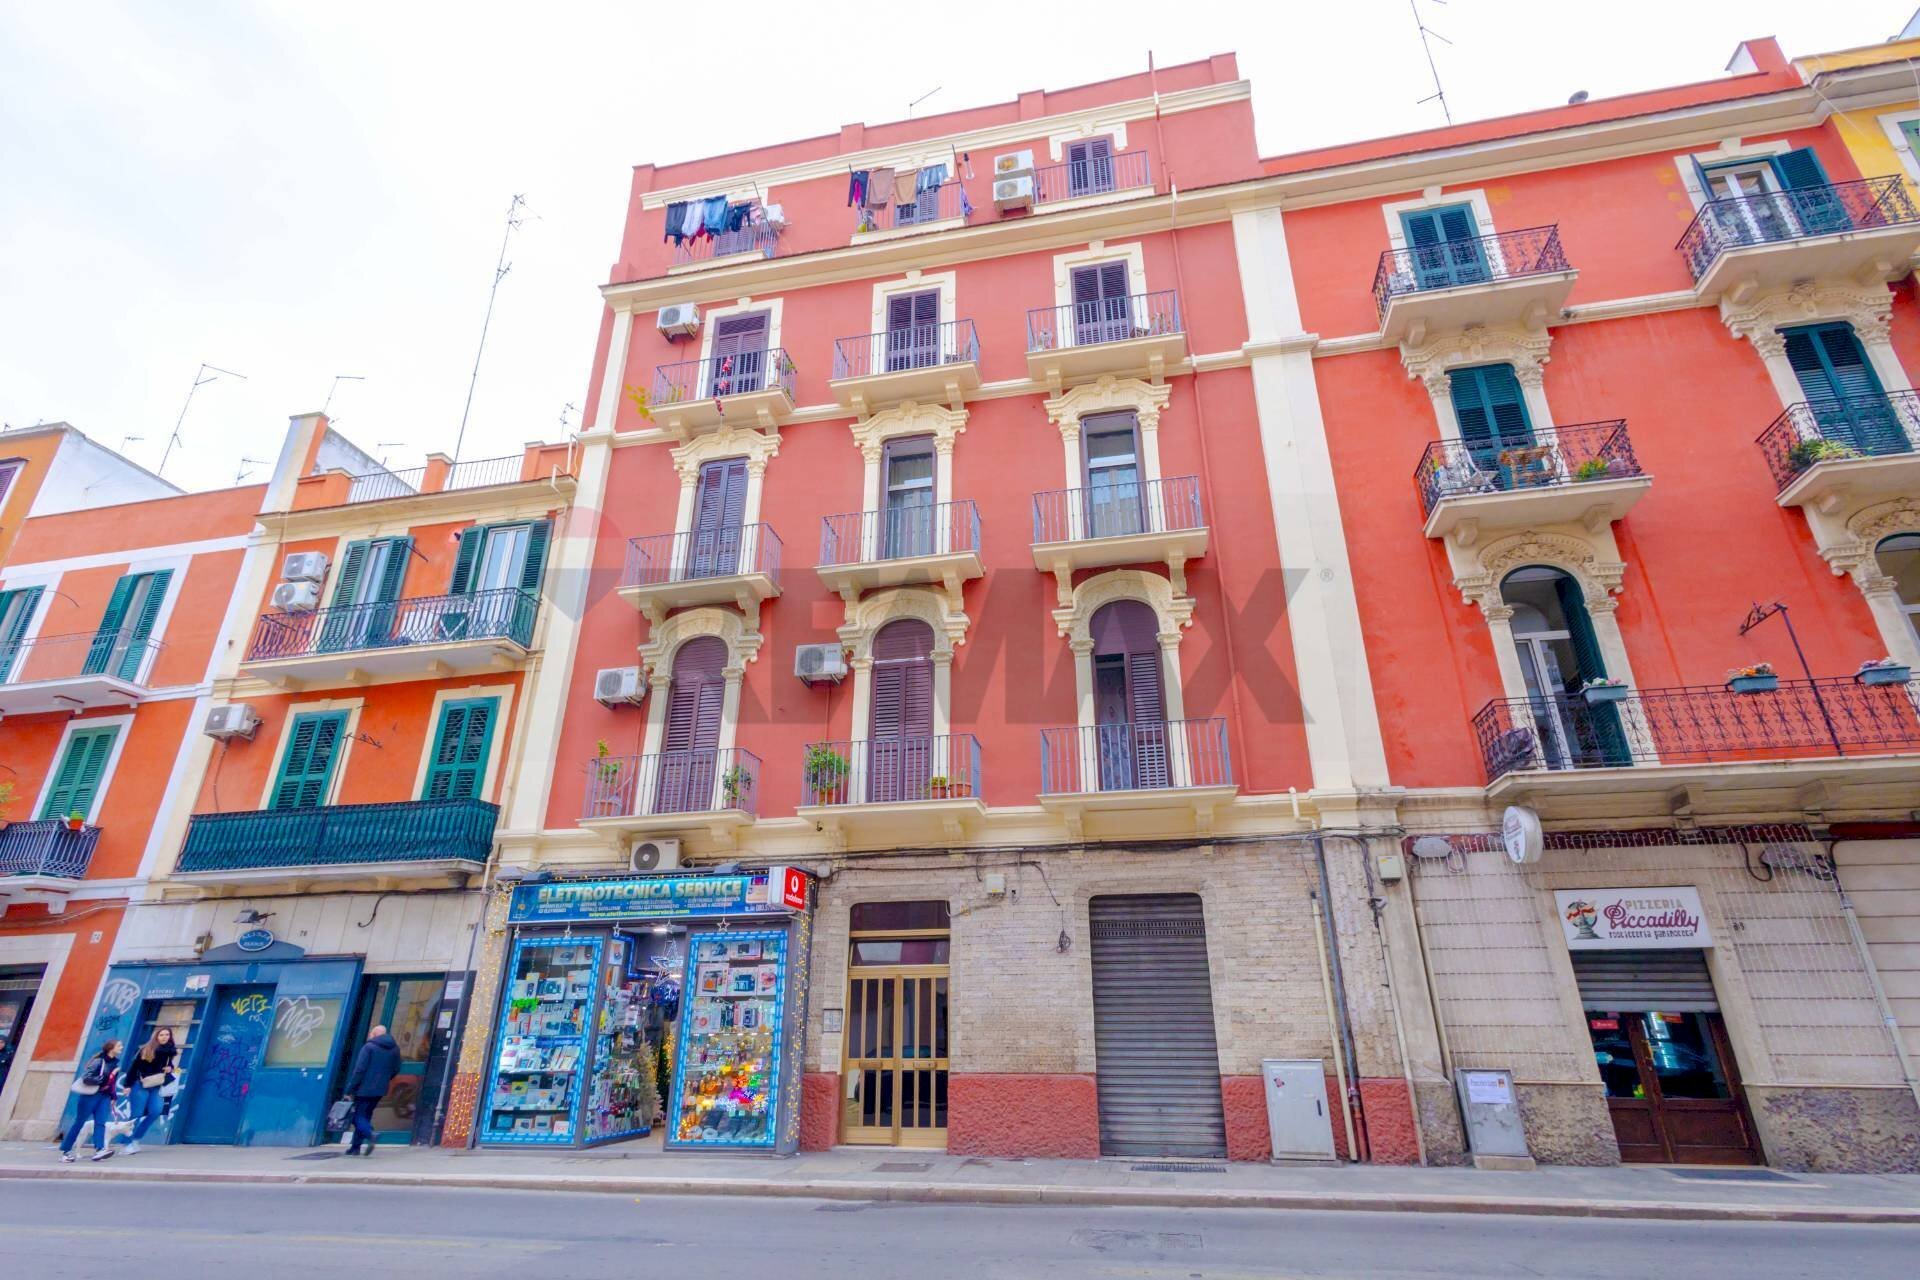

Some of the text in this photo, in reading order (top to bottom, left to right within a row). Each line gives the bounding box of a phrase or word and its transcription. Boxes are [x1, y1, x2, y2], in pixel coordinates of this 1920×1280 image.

[538, 883, 671, 900] ELETTROTECNICA
[675, 880, 742, 898] SERVICE
[785, 893, 803, 905] vodafone
[1625, 899, 1684, 910] PIZZERIA
[1604, 899, 1699, 932] Piccadilly
